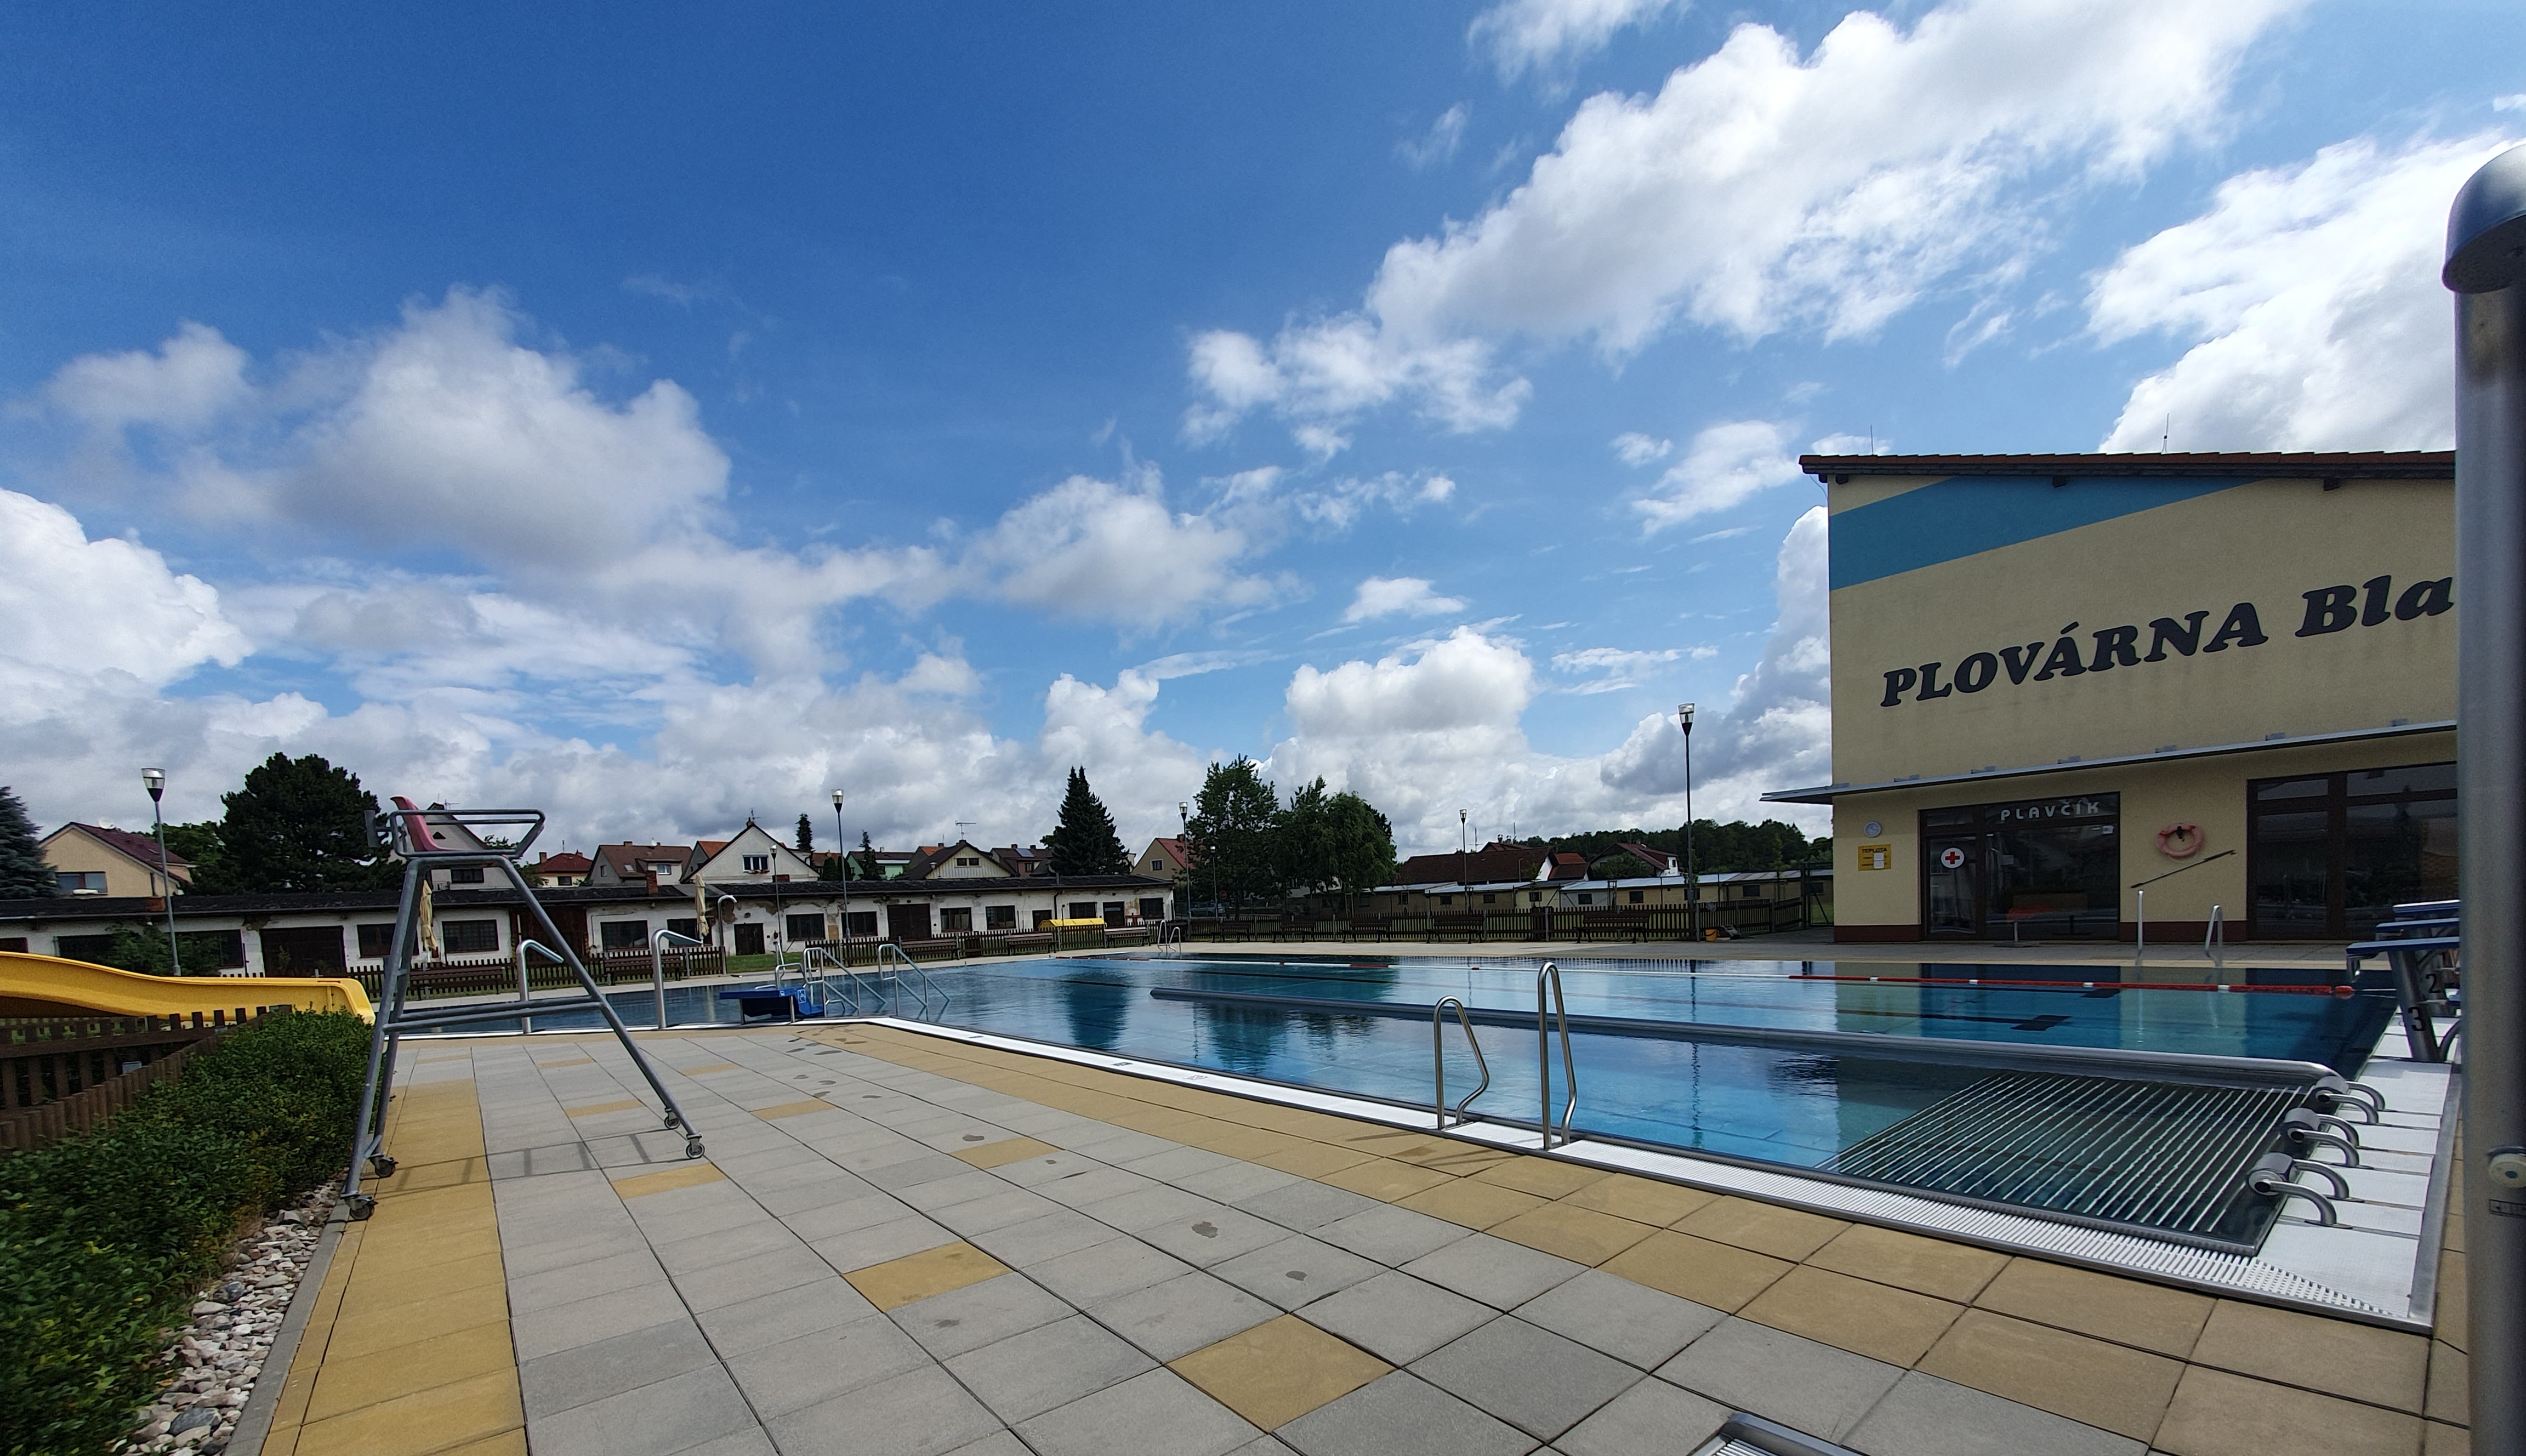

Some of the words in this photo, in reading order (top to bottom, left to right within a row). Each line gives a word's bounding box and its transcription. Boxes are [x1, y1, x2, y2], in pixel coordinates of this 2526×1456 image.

[1880, 601, 2269, 707] PLOVÁRNA
[2295, 575, 2455, 638] Bla
[2001, 800, 2099, 821] PLAVČÍK
[2426, 974, 2442, 993] 2
[2408, 1006, 2424, 1031] 3
